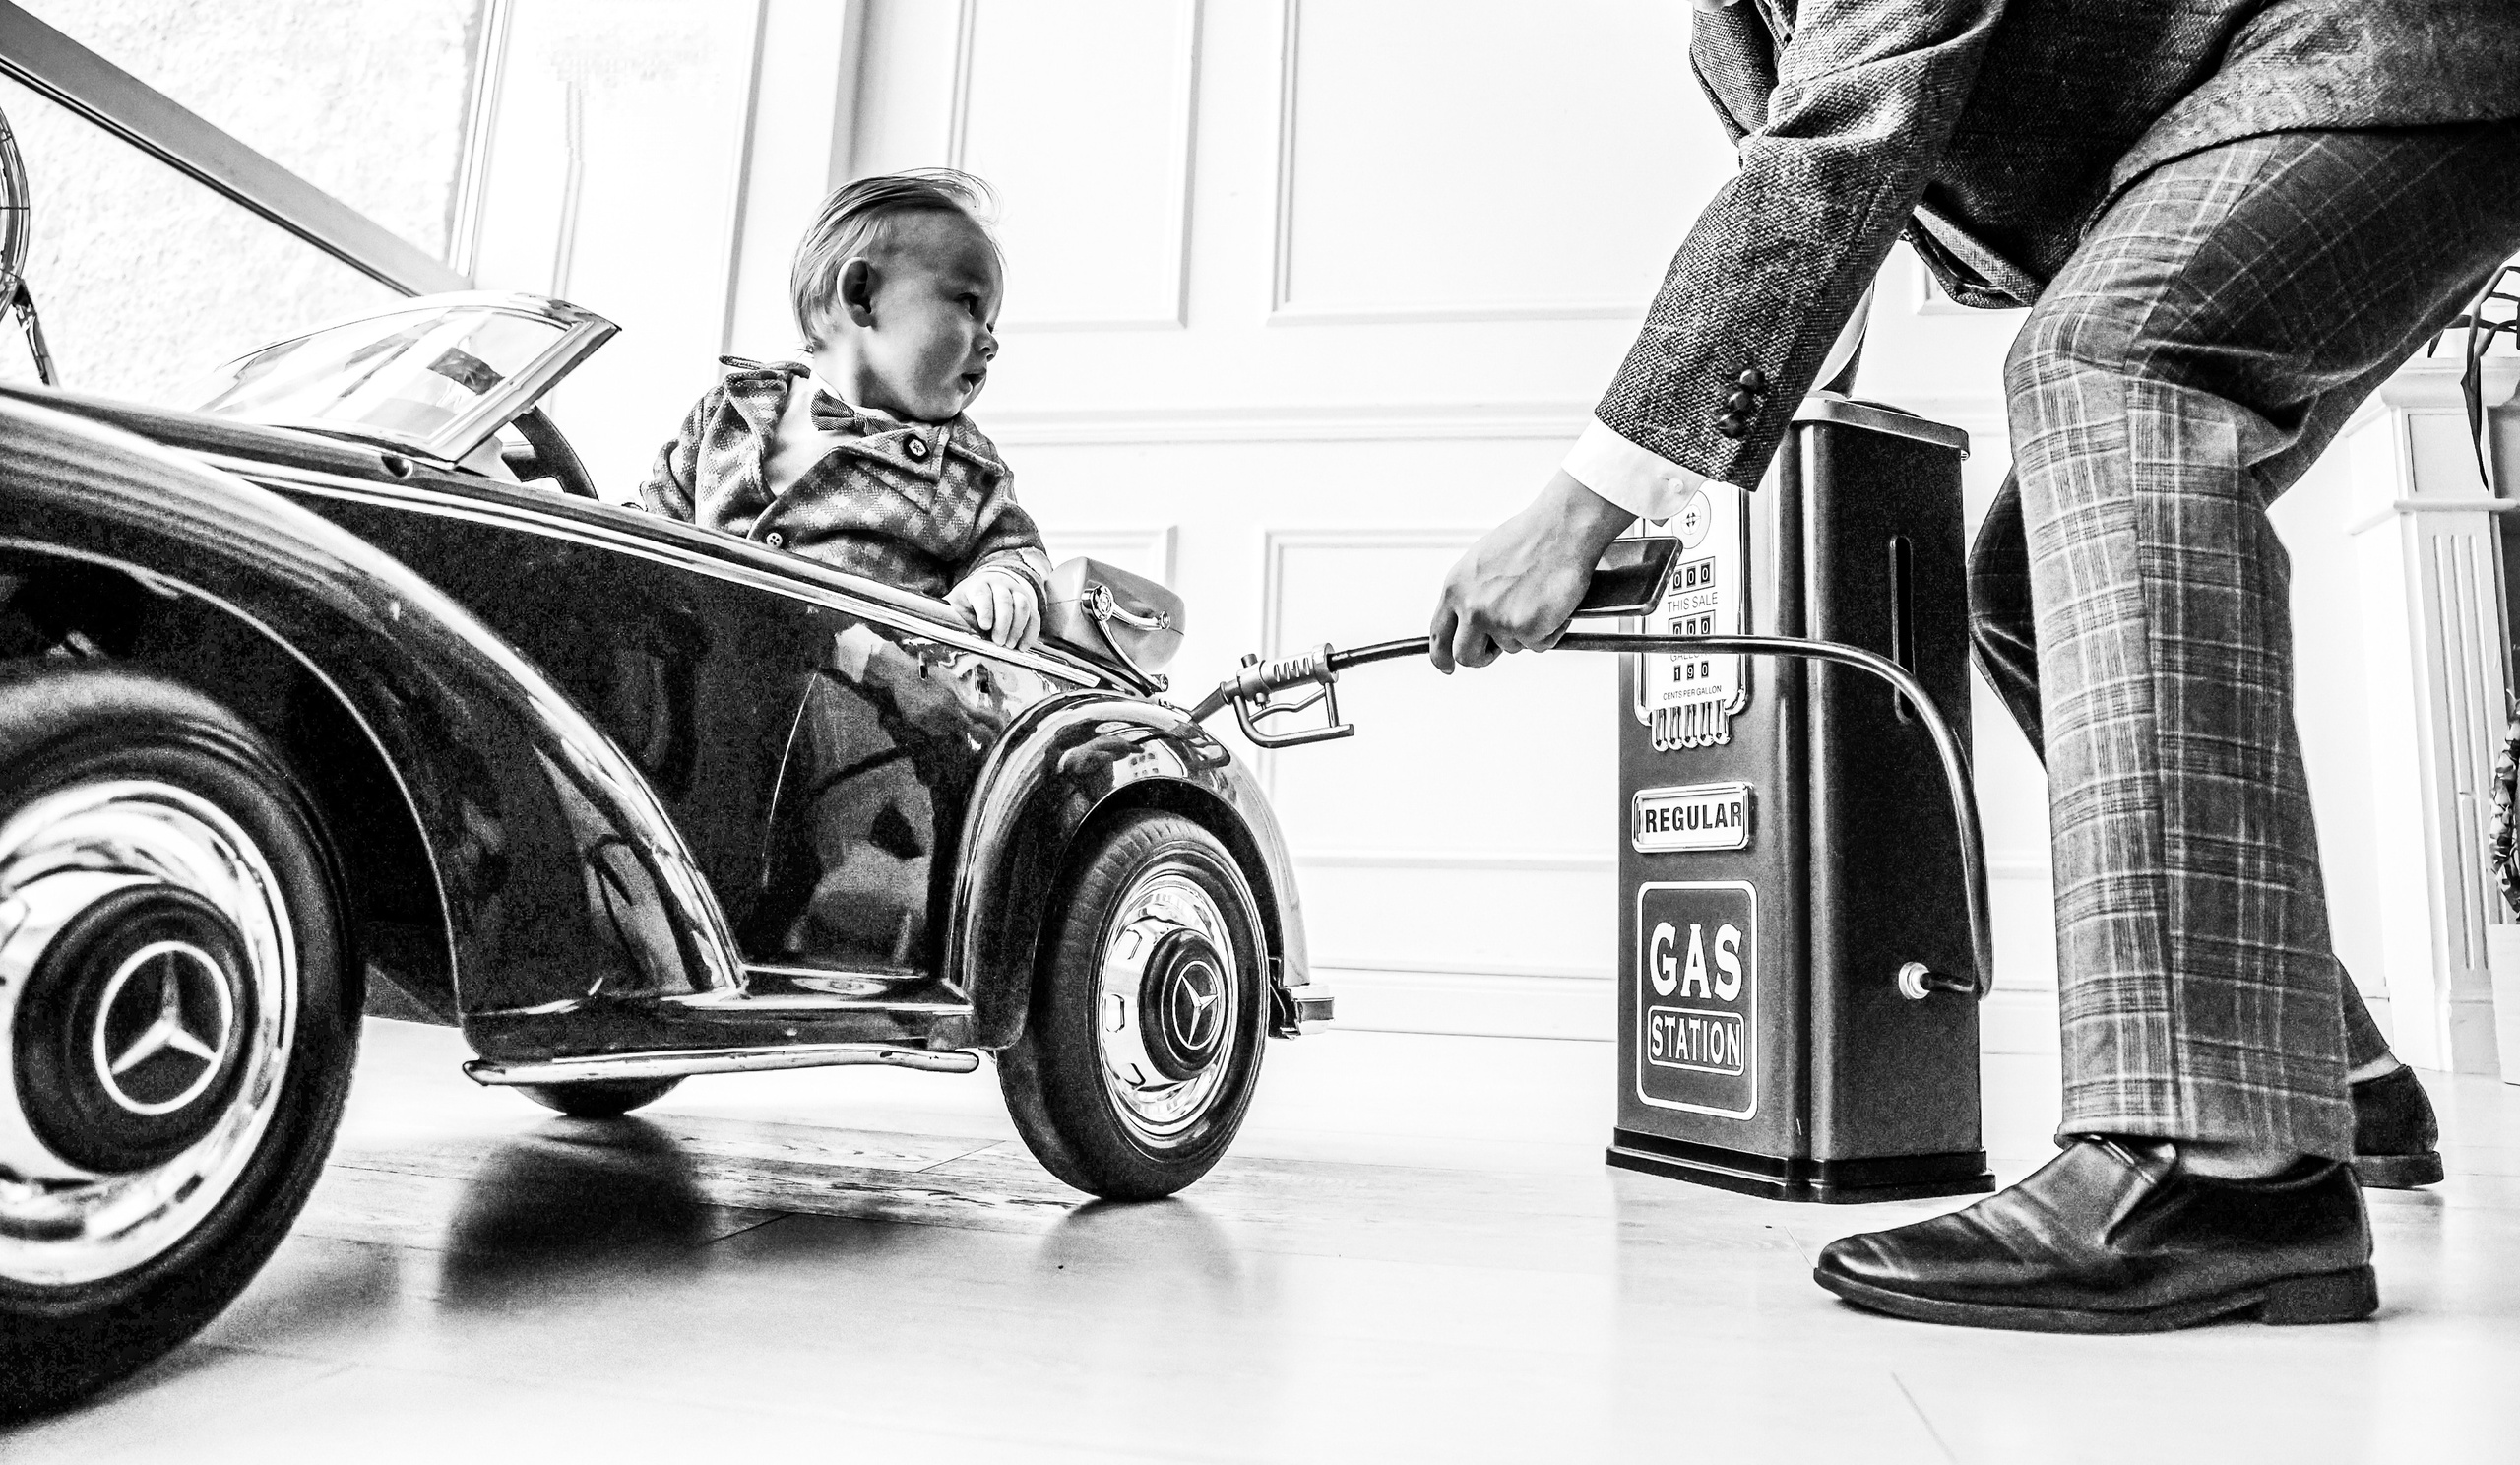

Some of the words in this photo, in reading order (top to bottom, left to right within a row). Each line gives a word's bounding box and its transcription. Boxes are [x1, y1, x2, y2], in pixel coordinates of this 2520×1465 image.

[1668, 597, 1690, 613] THIS
[1691, 591, 1719, 608] SALE
[1663, 690, 1683, 700] CENTS
[1683, 688, 1696, 698] PER
[1696, 684, 1722, 696] GALLON
[1645, 801, 1742, 834] REGULAR
[1649, 921, 1743, 1002] GAS
[1651, 1014, 1741, 1067] STATION
